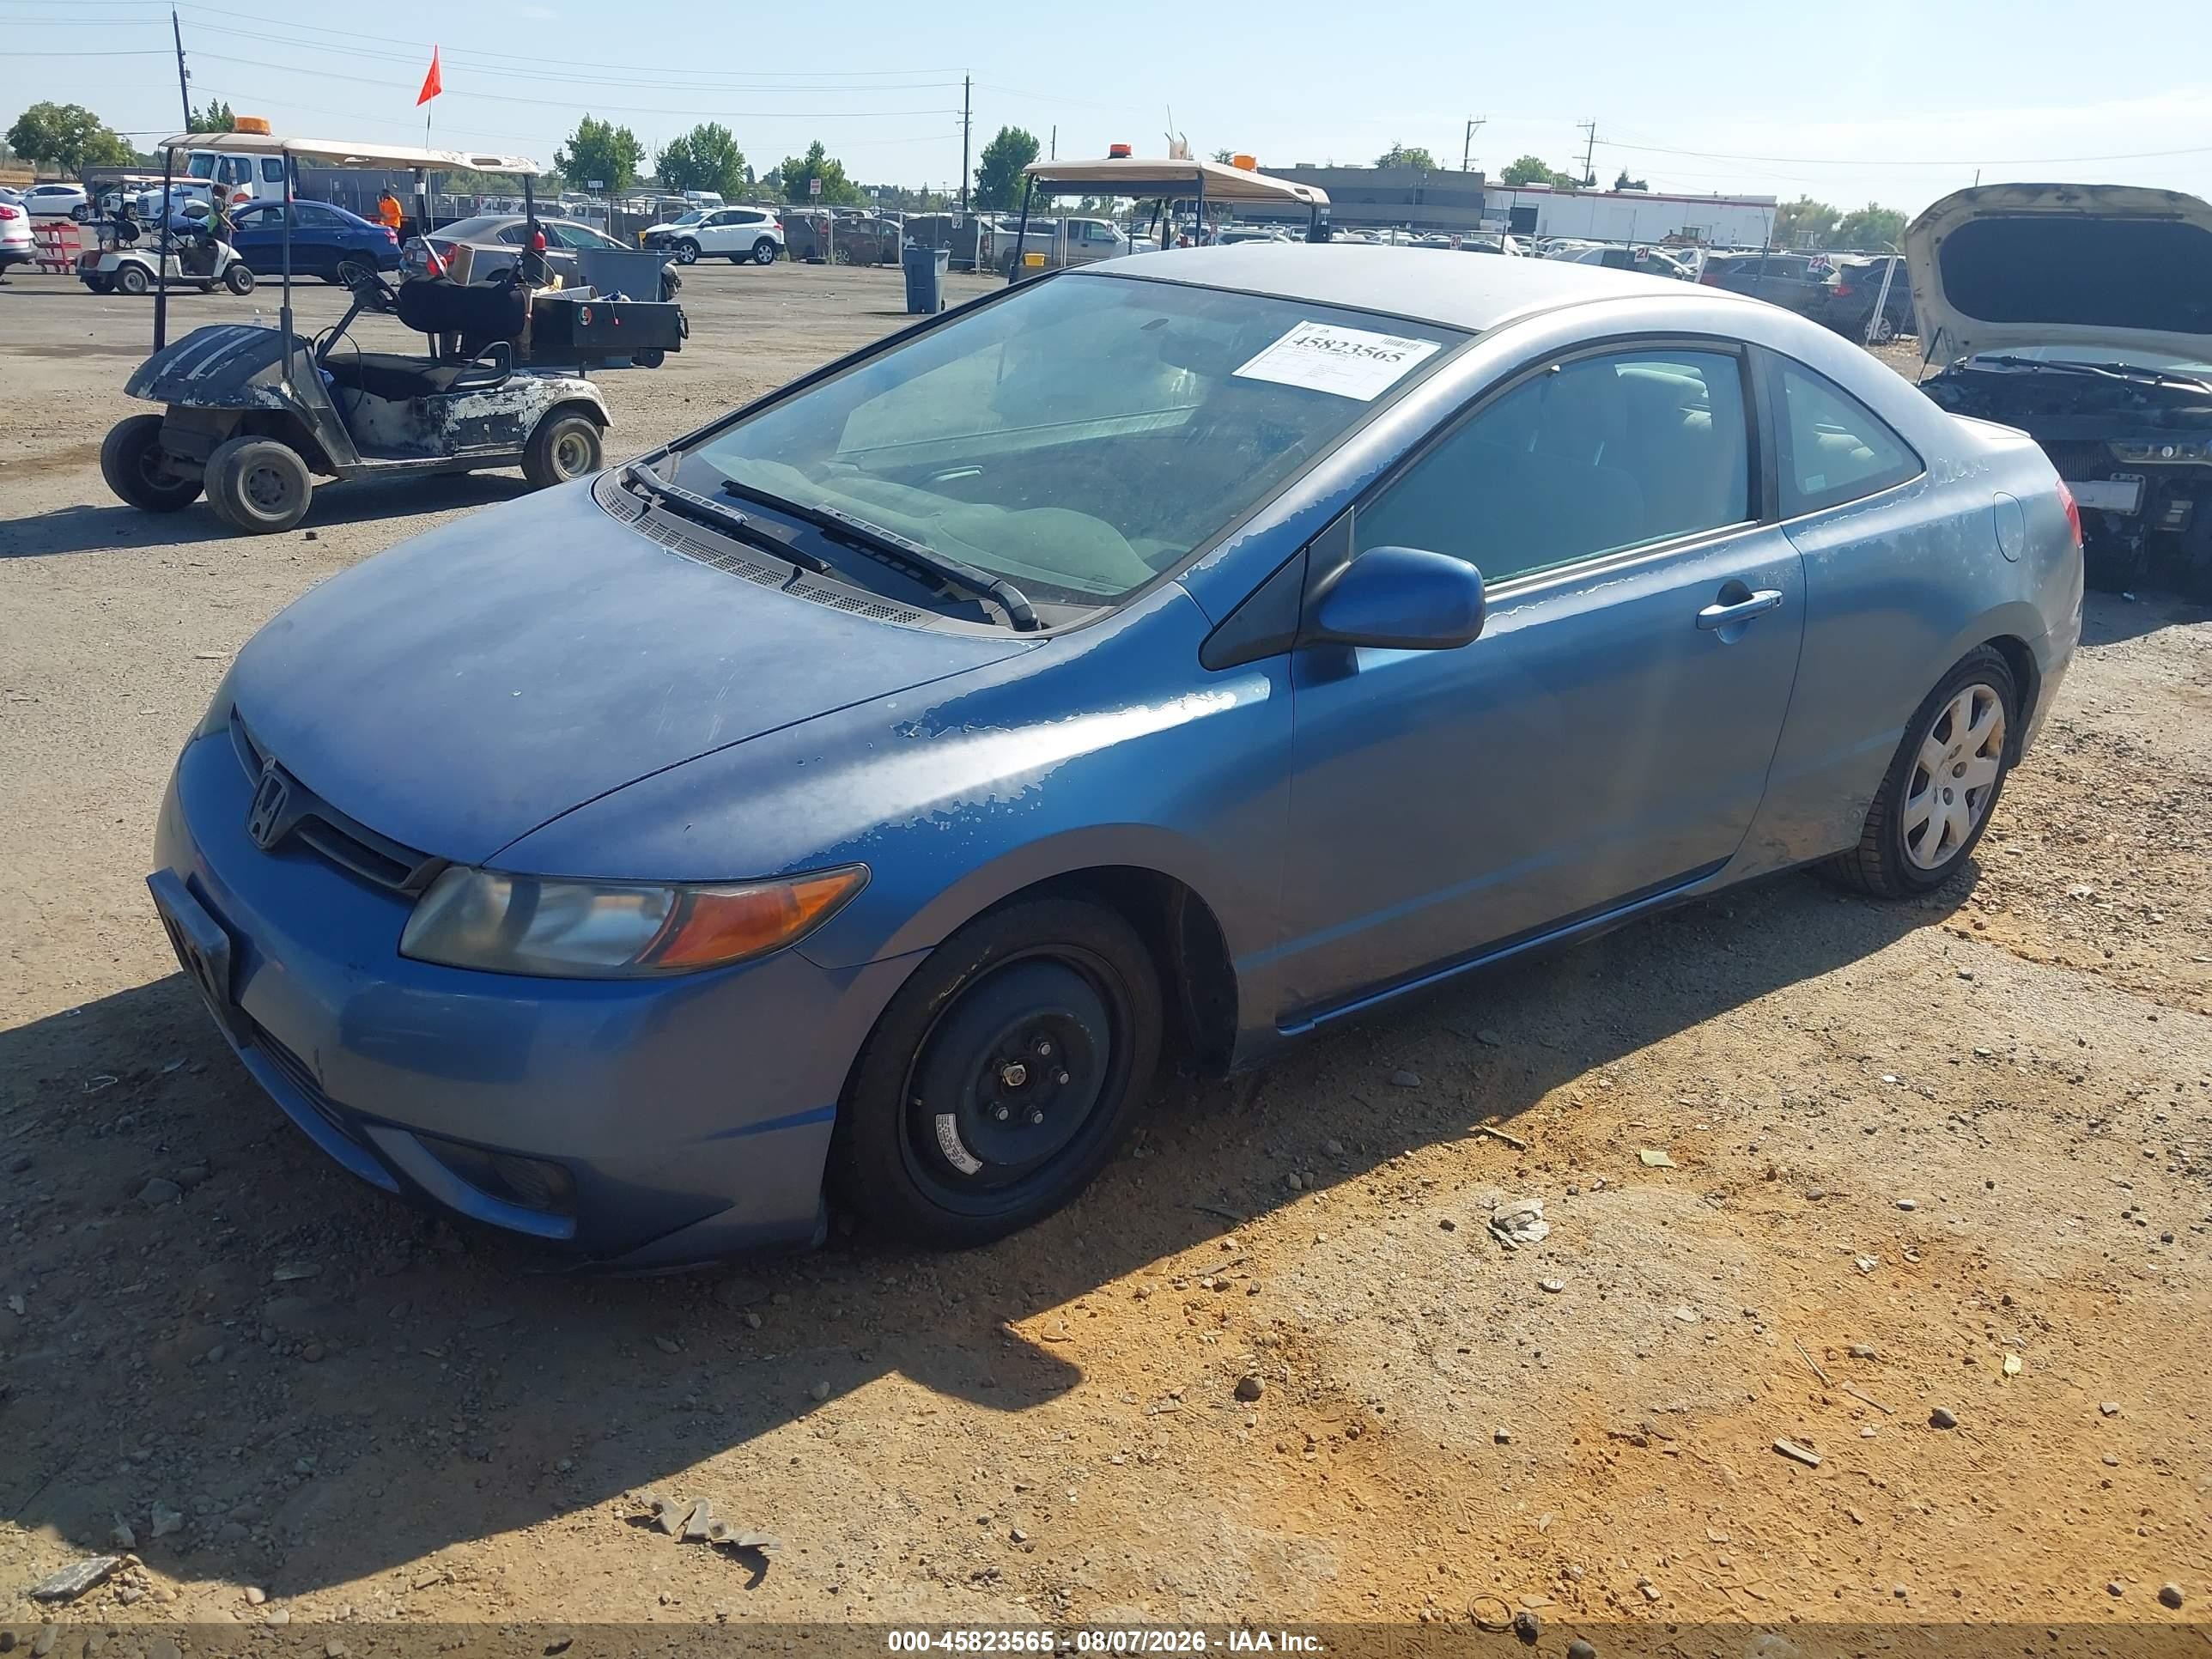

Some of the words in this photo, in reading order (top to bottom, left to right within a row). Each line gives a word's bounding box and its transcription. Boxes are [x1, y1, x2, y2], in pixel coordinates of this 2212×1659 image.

[1451, 236, 1462, 246] 20
[1637, 247, 1650, 258] 21
[1810, 257, 1826, 269] 22
[1293, 336, 1406, 362] 45823565
